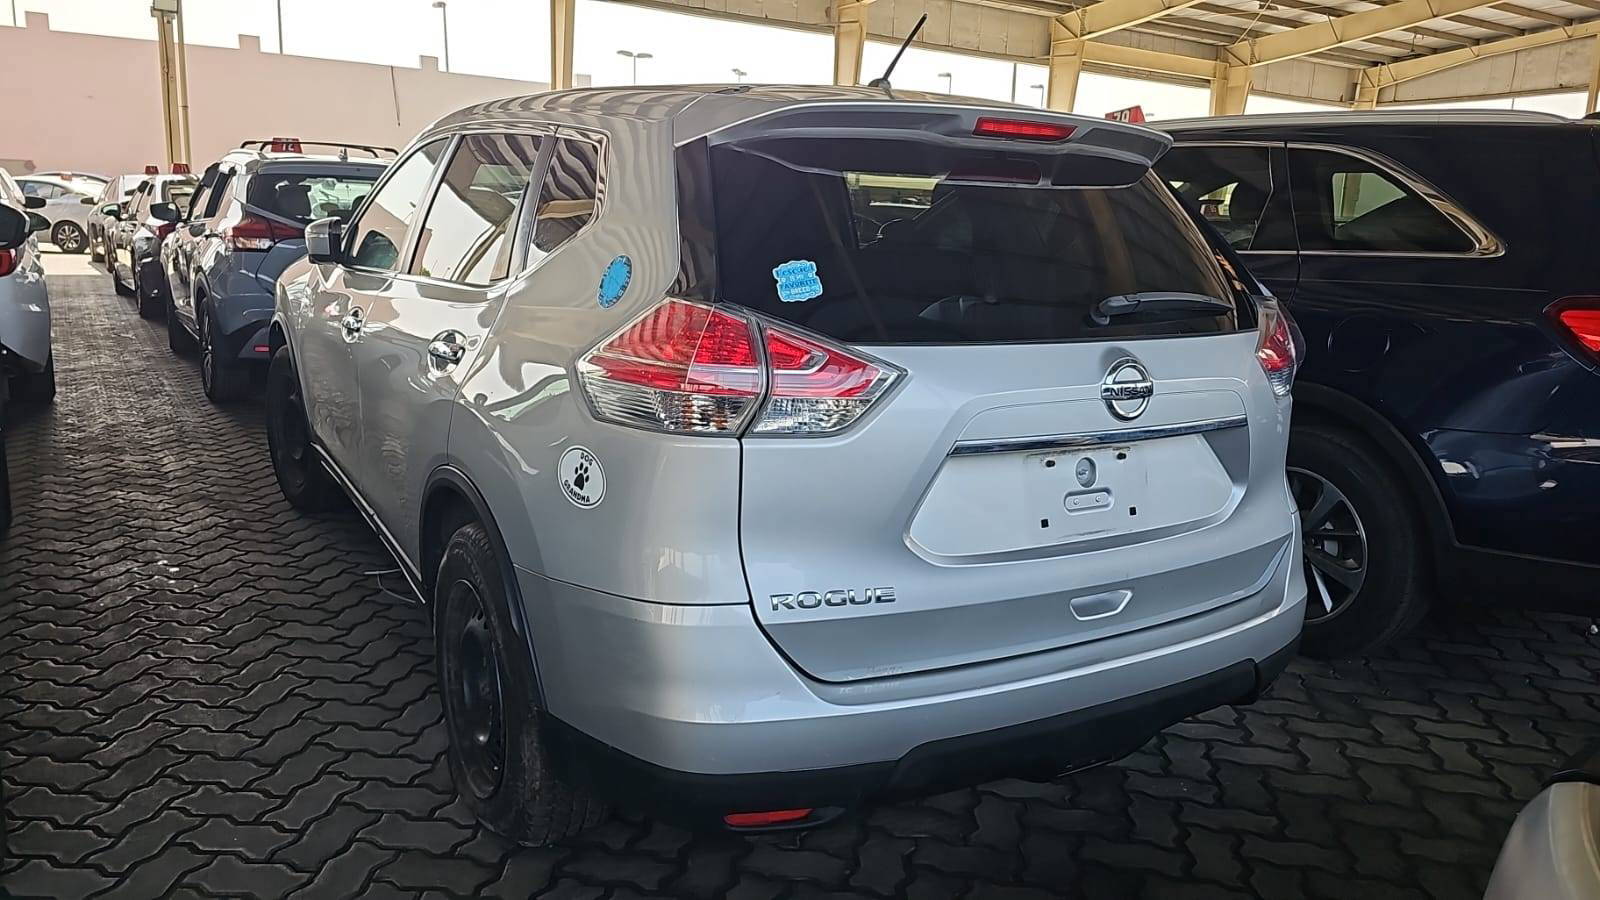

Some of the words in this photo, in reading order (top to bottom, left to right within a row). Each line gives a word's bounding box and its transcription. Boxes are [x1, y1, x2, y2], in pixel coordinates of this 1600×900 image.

[1110, 385, 1152, 397] NISSAN
[580, 452, 593, 466] DOG
[563, 480, 590, 503] GRANDMA
[769, 586, 896, 611] ROGUE
